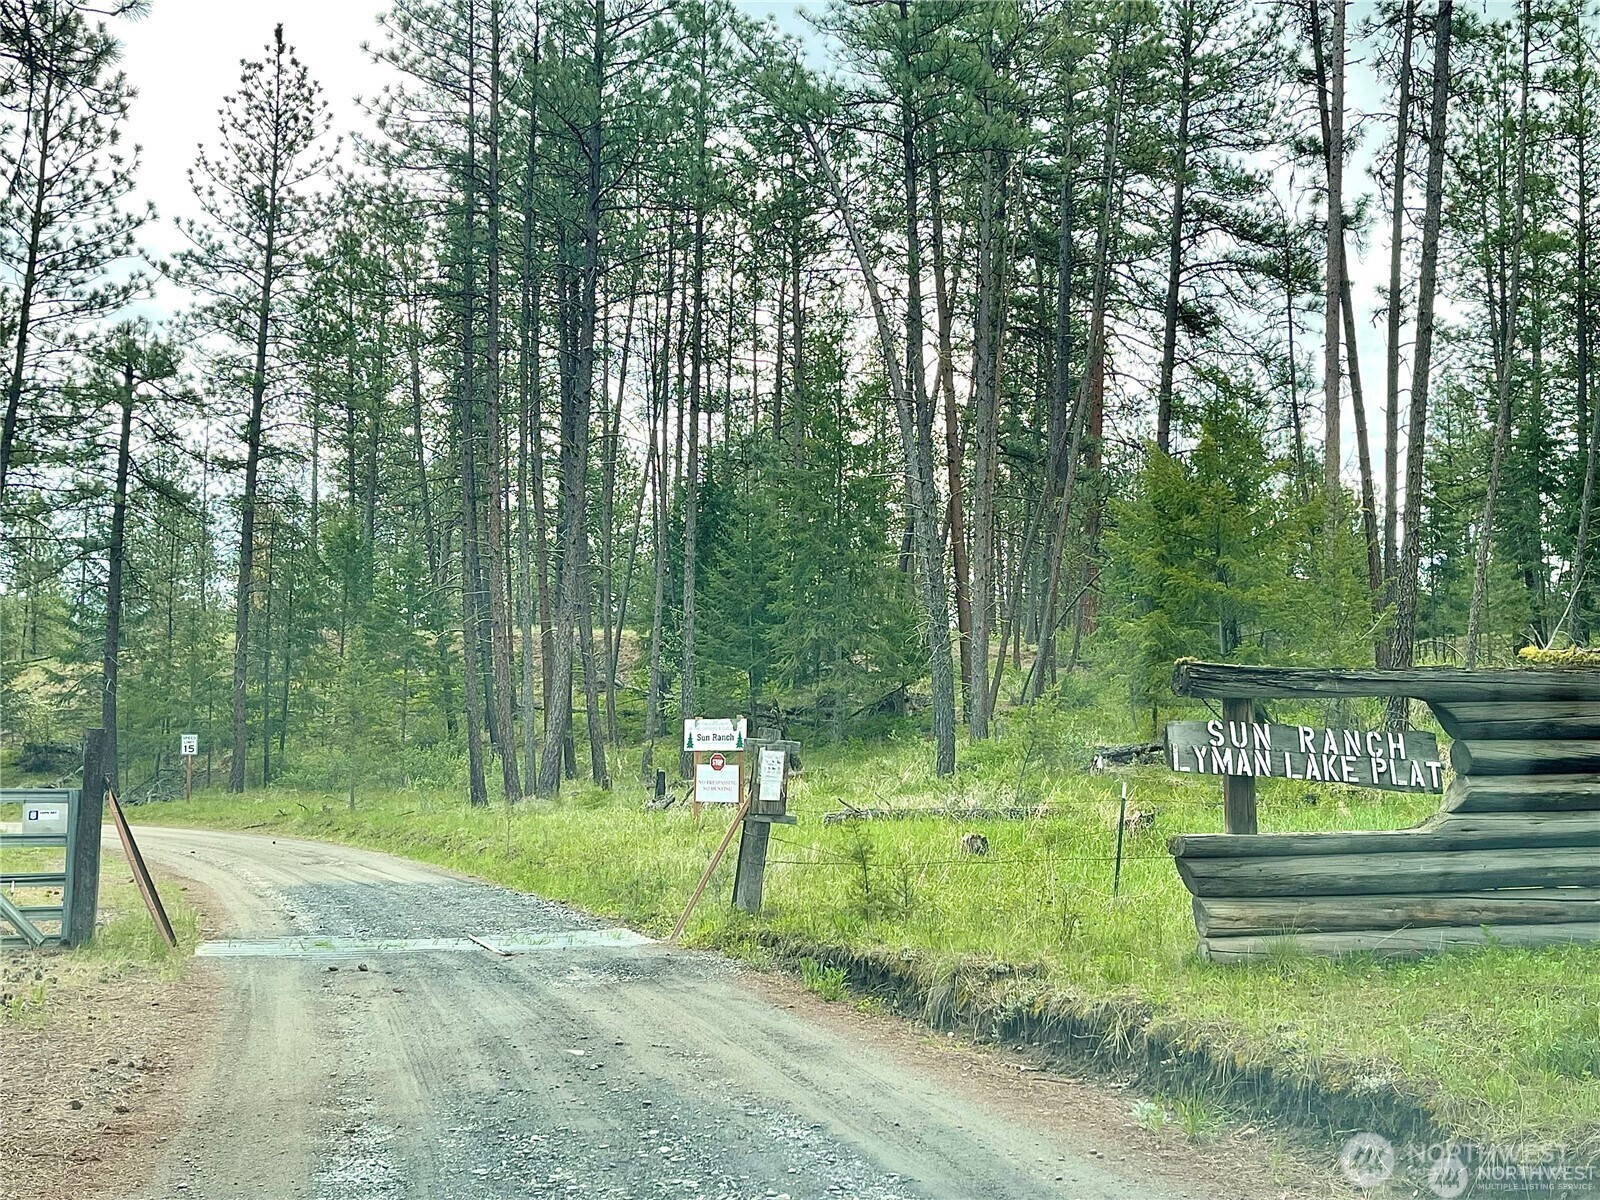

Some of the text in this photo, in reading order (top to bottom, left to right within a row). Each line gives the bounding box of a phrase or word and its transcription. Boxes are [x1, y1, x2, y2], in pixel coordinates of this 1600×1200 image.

[696, 733, 735, 742] Sun Ranch
[1207, 720, 1406, 760] SUN RANCH
[712, 758, 724, 766] STOP
[1171, 743, 1442, 789] LYMAN LAKE PLAT
